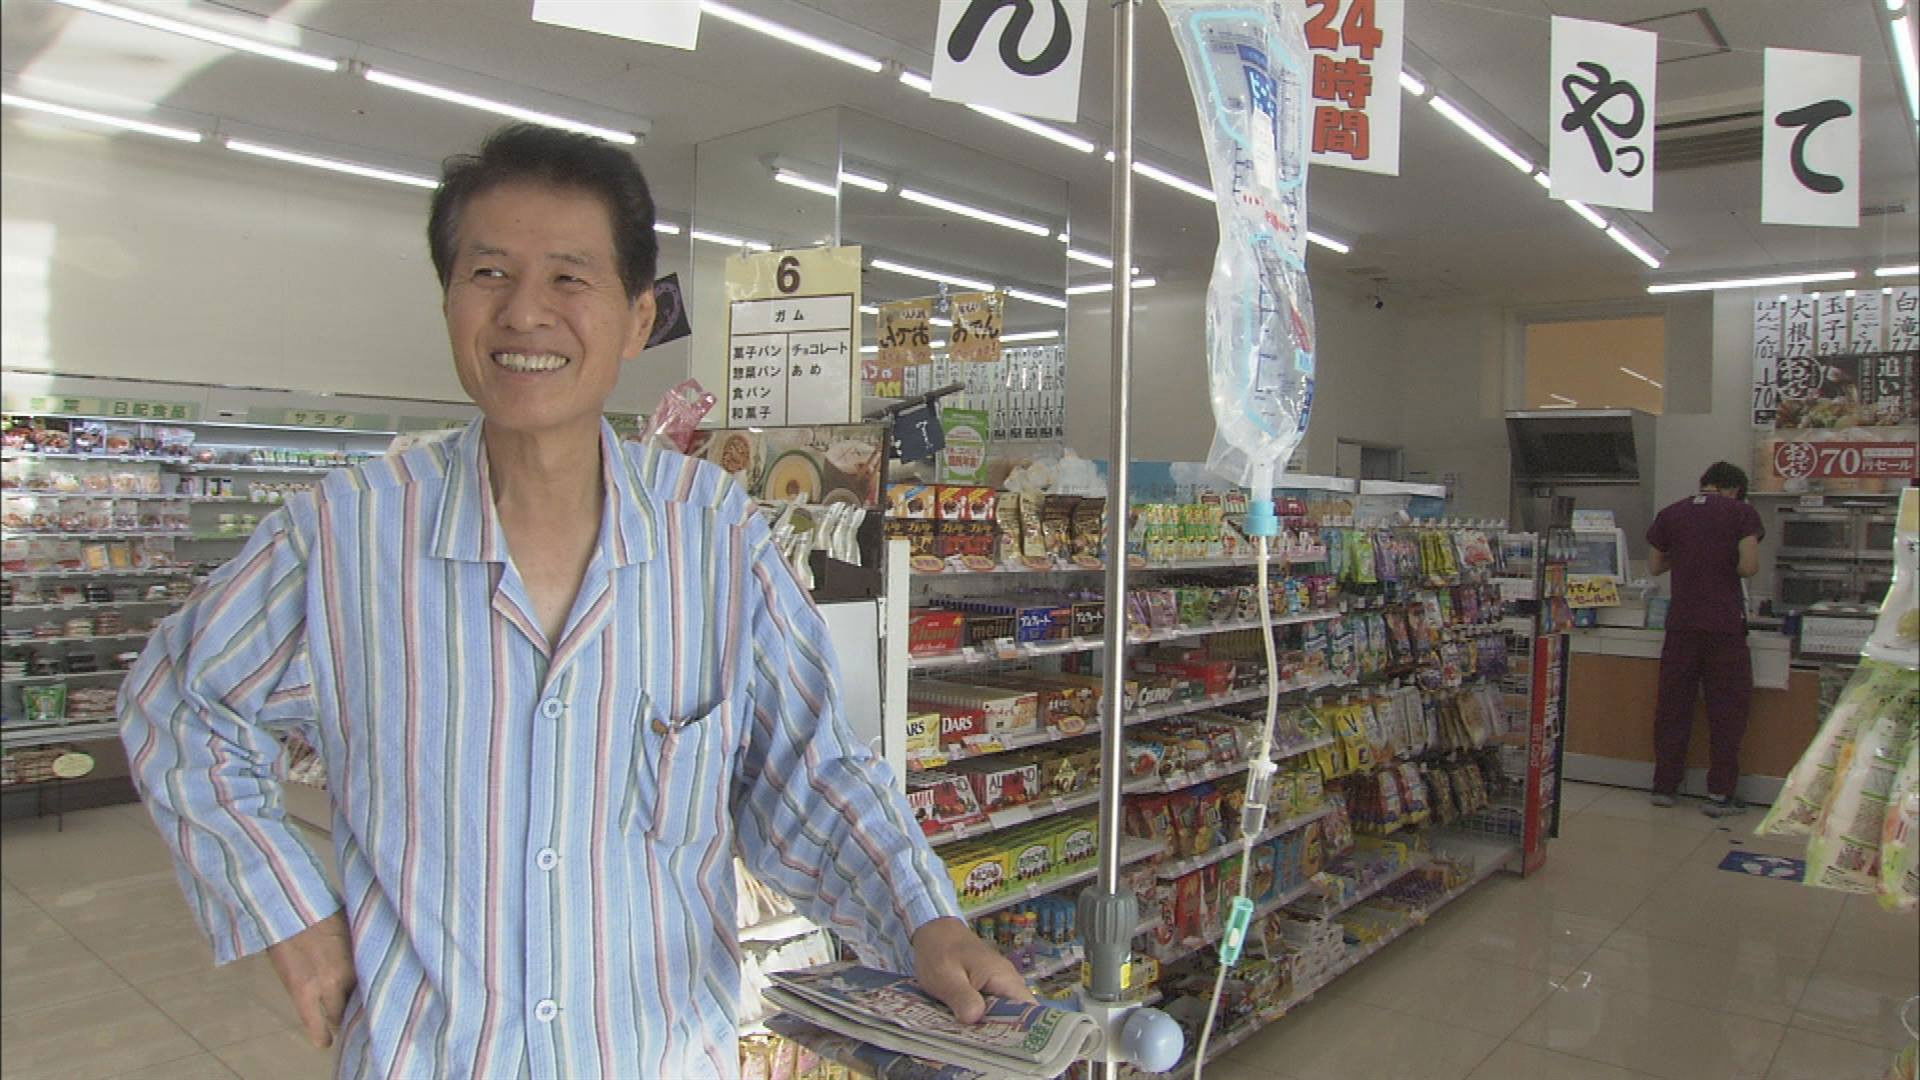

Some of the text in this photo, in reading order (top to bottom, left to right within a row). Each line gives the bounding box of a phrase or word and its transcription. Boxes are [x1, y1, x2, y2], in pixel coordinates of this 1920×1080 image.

[1304, 0, 1383, 160] 24時間
[1774, 99, 1852, 194] て
[776, 256, 800, 294] 6
[775, 310, 804, 322] ガム
[1789, 299, 1812, 342] 大根
[1821, 297, 1846, 341] 玉子
[733, 345, 781, 359] 菓子パン
[792, 341, 848, 356] チョコレート
[792, 365, 822, 377] あめ
[733, 387, 771, 400] 食パン
[732, 406, 772, 419] 和菓子
[942, 715, 973, 734] DARS
